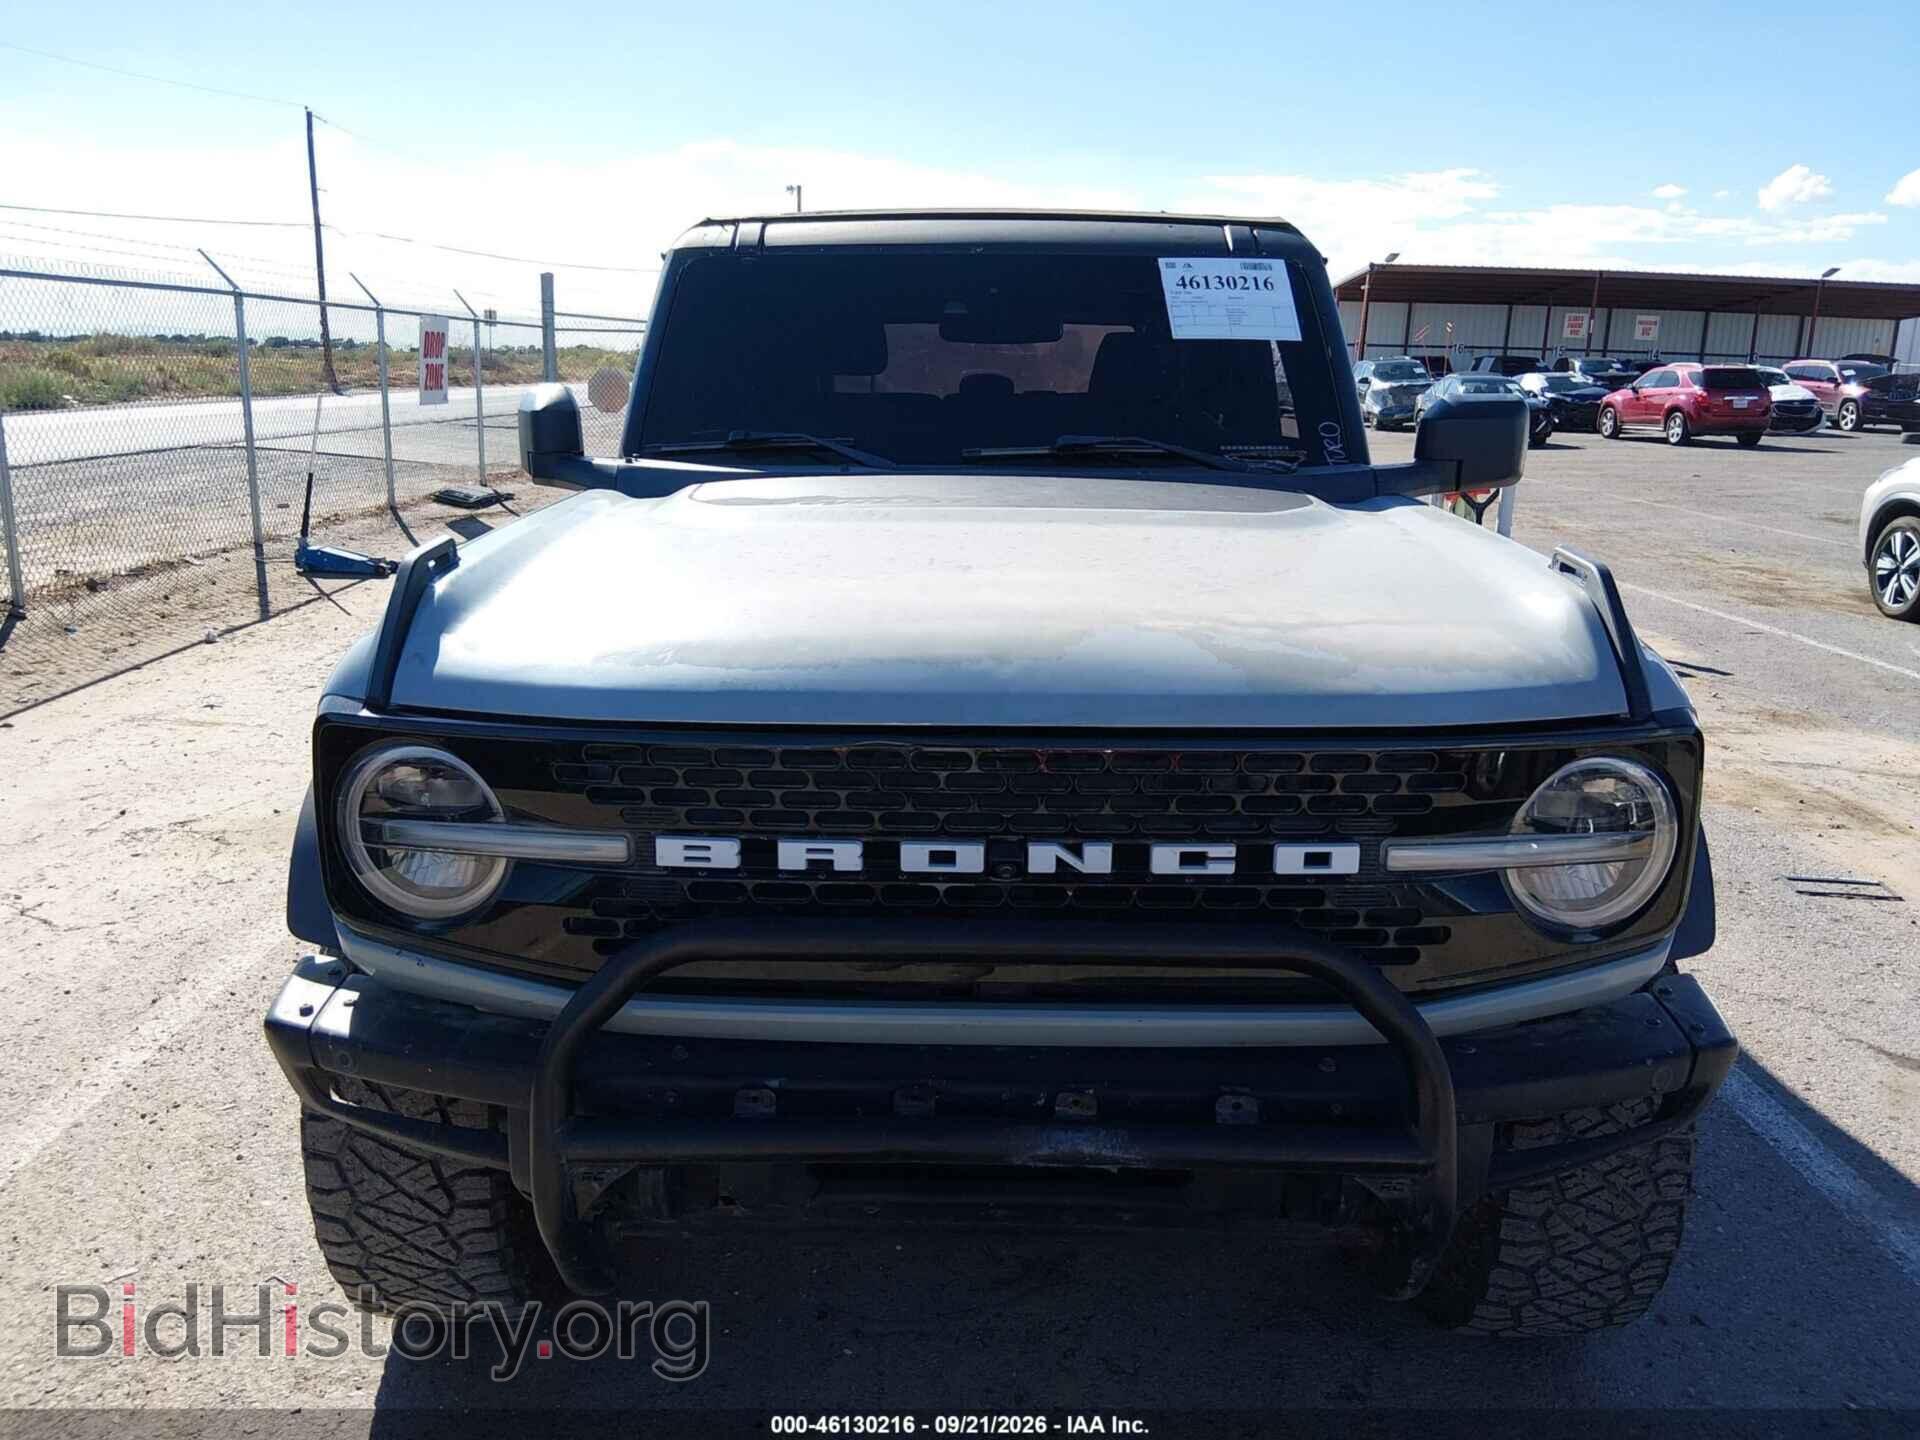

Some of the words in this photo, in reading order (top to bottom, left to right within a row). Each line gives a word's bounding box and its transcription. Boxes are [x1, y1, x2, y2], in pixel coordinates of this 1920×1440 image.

[1175, 275, 1275, 291] 46130216
[423, 331, 446, 358] DROP
[424, 363, 444, 391] ZONE
[655, 836, 1361, 876] BRONCO
